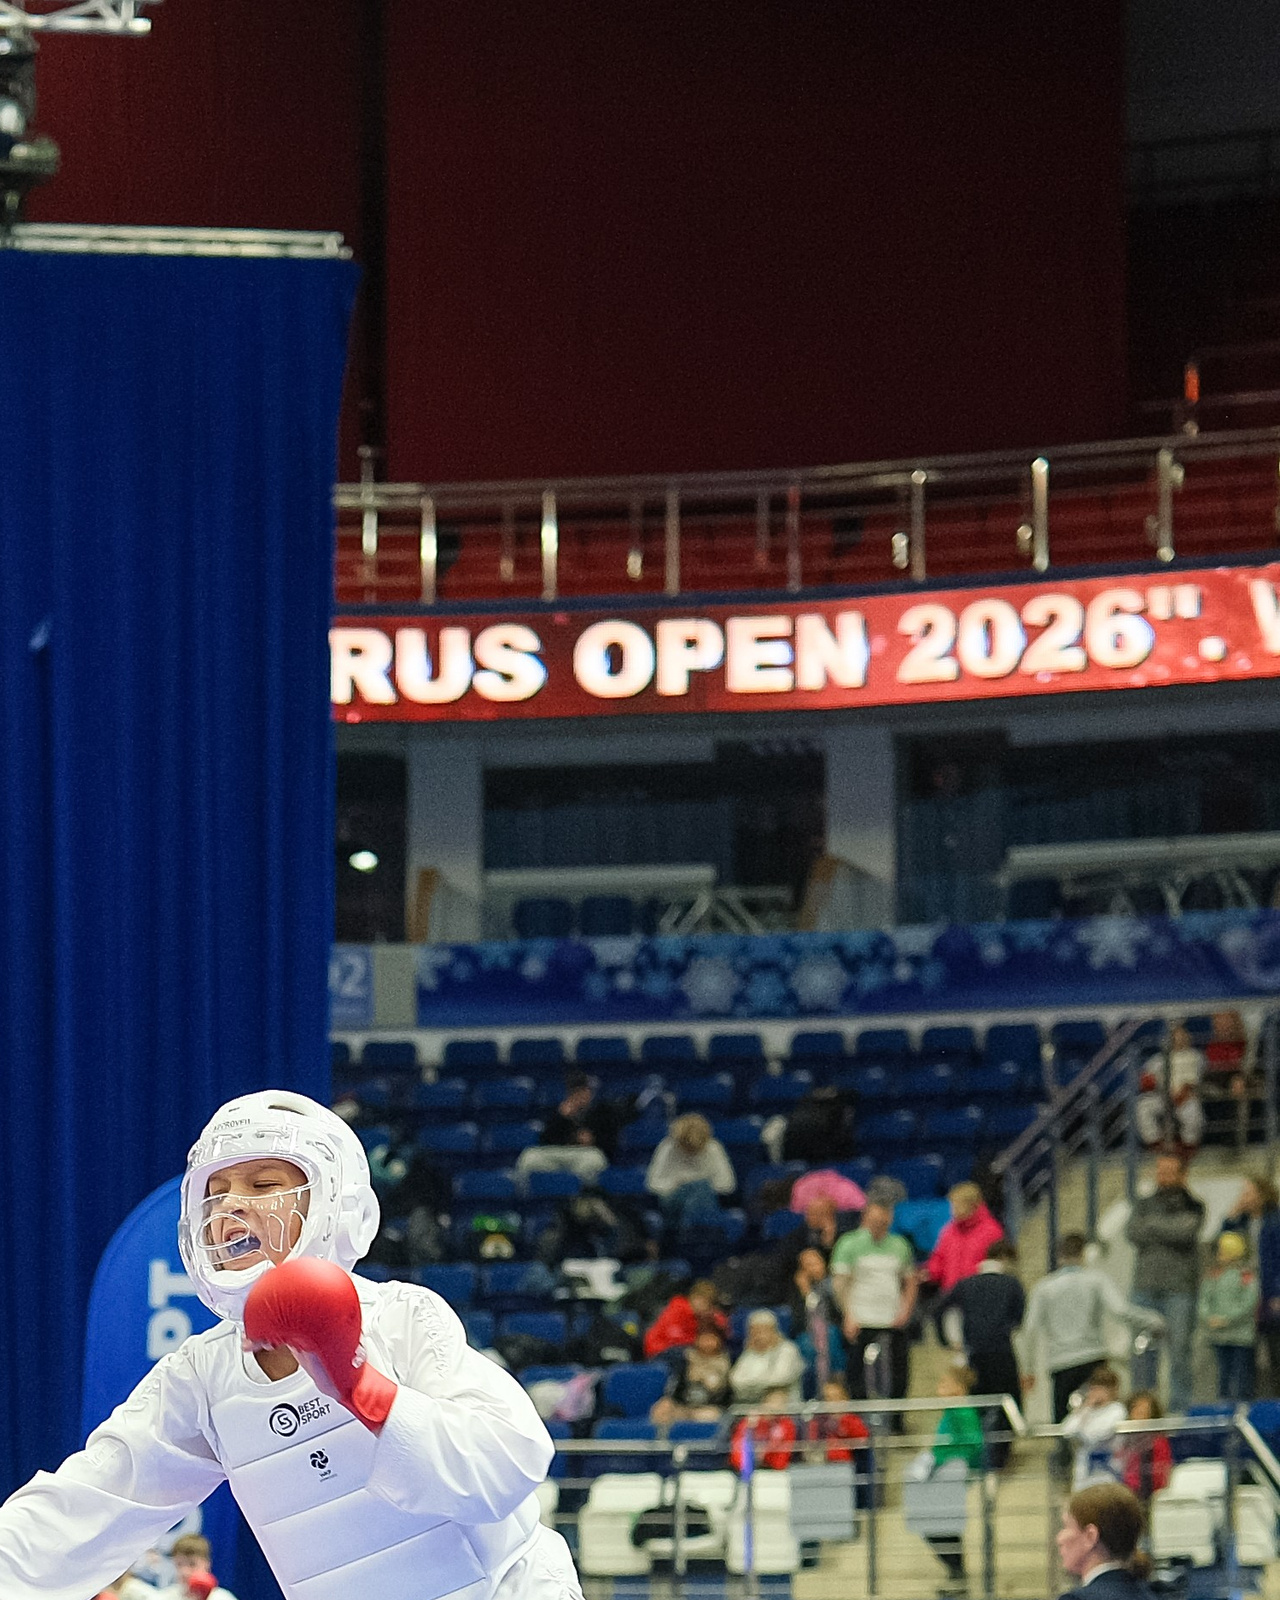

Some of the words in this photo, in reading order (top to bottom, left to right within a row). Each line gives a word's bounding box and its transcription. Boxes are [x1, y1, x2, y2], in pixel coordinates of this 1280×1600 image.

[573, 610, 869, 698] OPEN
[298, 1397, 321, 1415] BEST
[301, 1403, 332, 1426] SPORT
